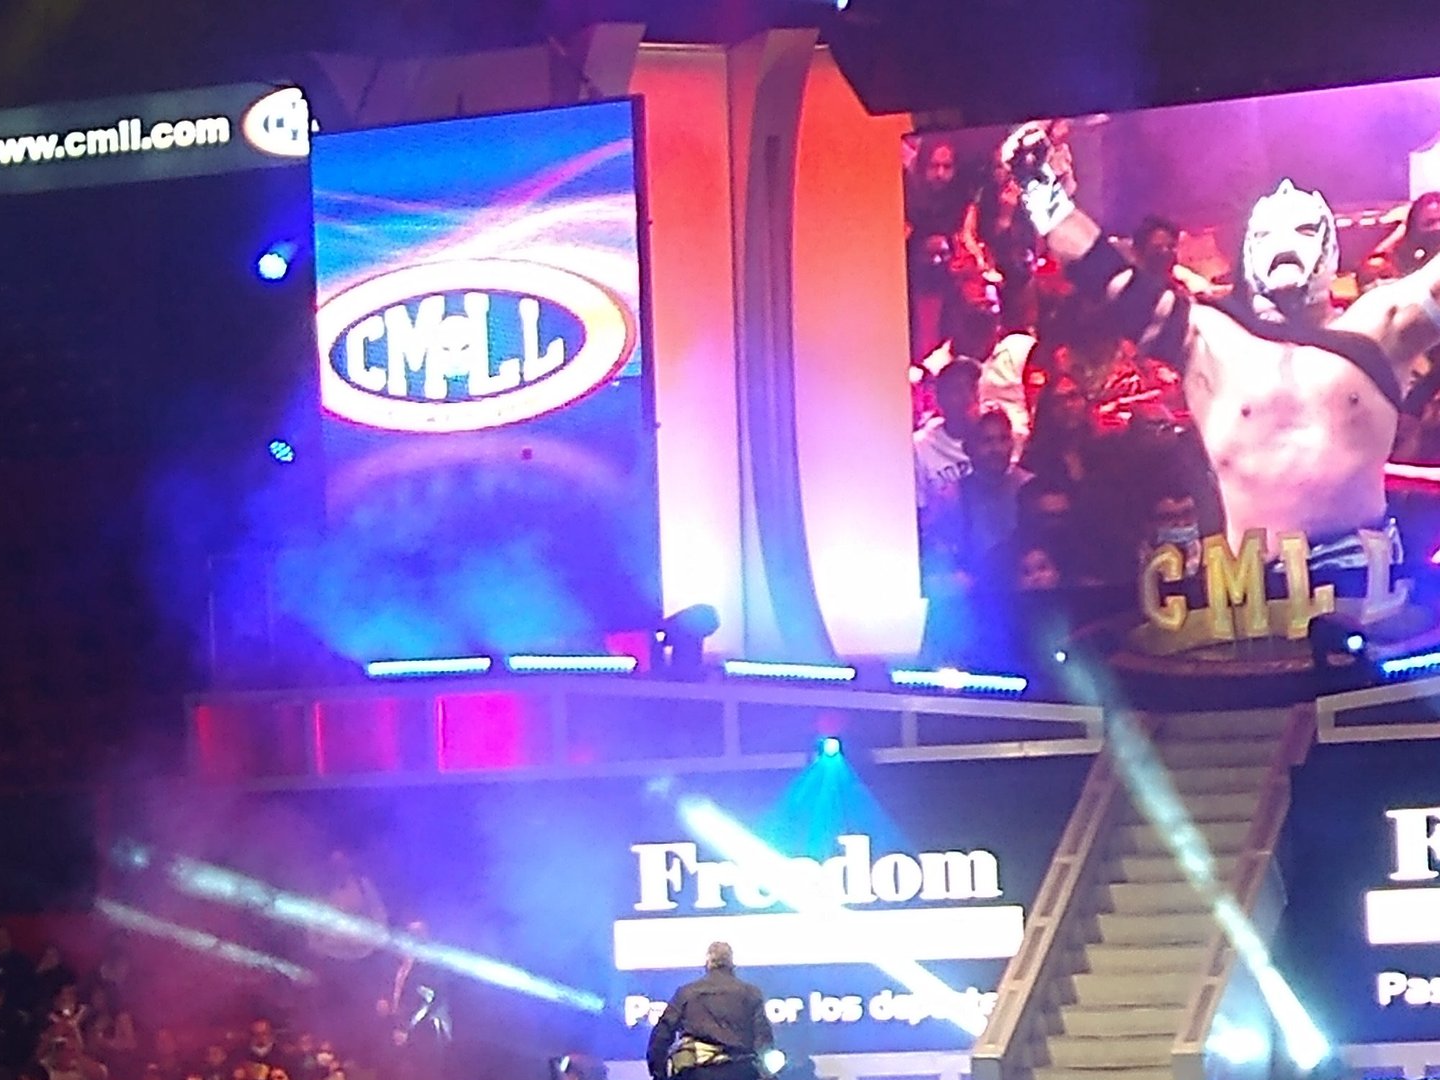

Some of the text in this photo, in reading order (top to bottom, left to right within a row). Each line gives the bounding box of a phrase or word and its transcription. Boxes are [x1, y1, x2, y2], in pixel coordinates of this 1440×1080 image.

[345, 291, 565, 398] CMLL
[1143, 526, 1415, 641] CMLL
[764, 997, 804, 1023] or
[810, 991, 863, 1022] los
